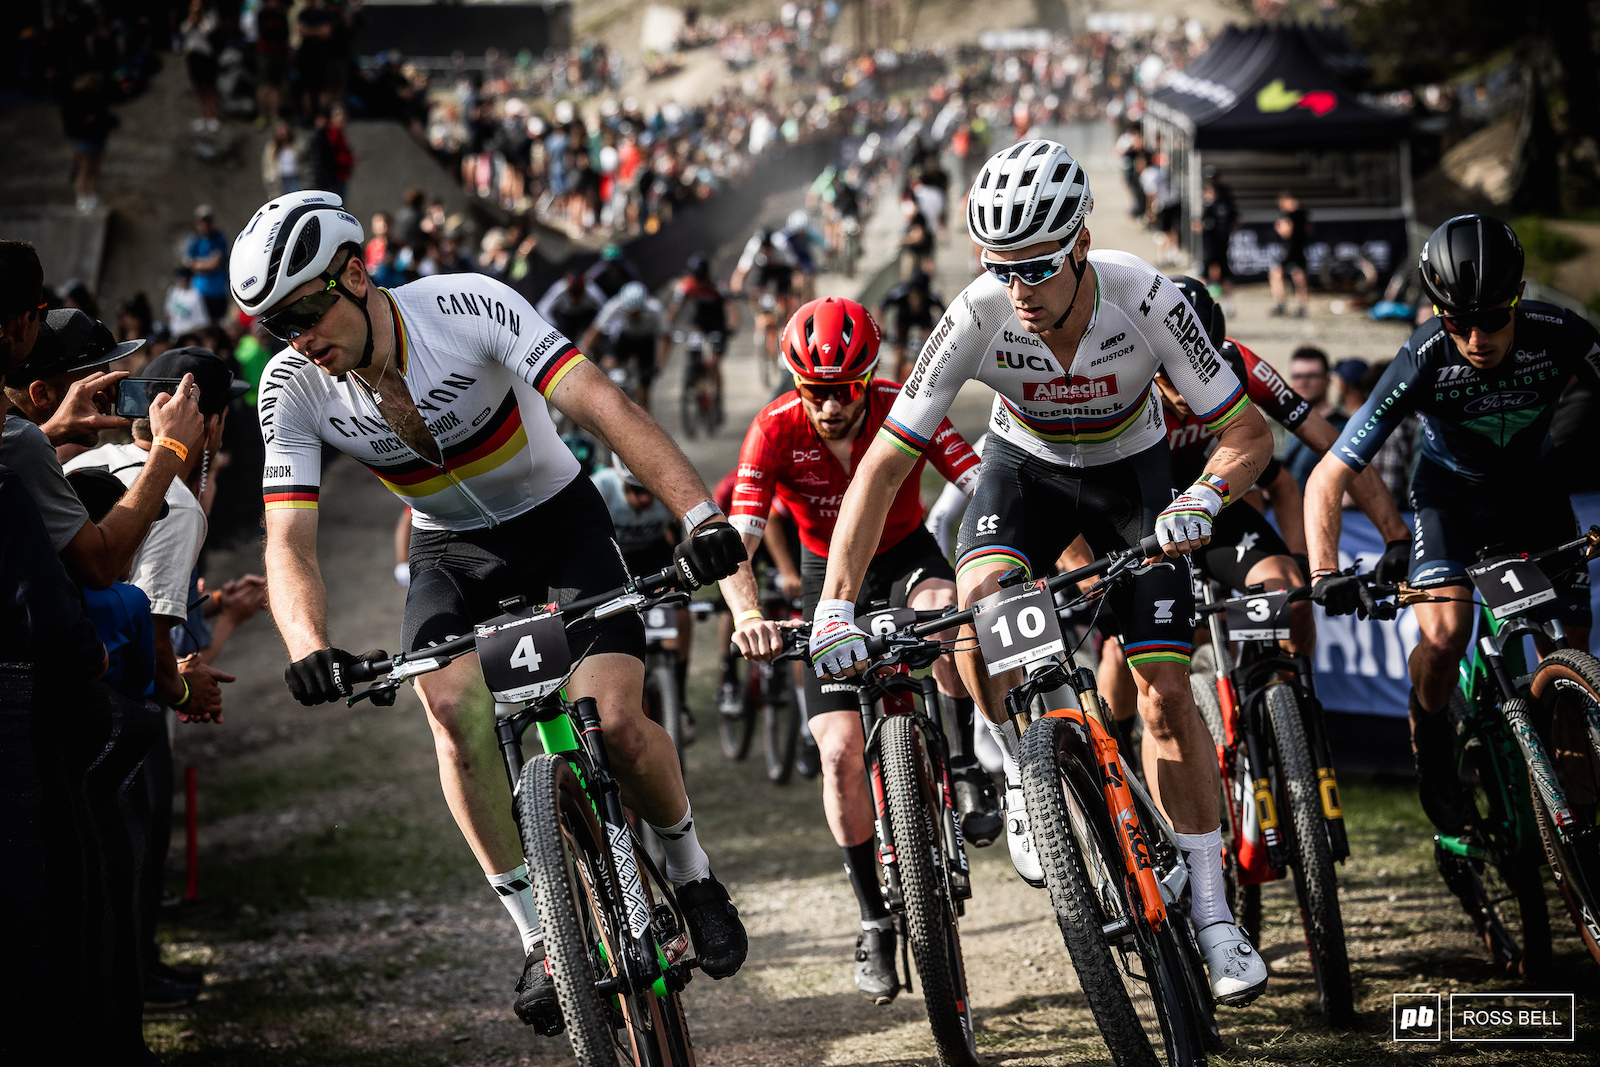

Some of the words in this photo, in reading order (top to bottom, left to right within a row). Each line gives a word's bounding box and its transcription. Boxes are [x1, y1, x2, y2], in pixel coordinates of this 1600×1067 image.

[1066, 195, 1089, 230] CANYON
[264, 220, 281, 254] CANYON
[1147, 274, 1164, 301] ZWIFT
[436, 292, 520, 337] CANYON
[904, 314, 956, 400] deceuninck
[1163, 317, 1182, 344] HAIR
[1183, 340, 1210, 386] BOOSTER
[1168, 301, 1221, 379] Alpecin
[928, 350, 951, 388] WINDOWS
[1006, 351, 1055, 372] UCI
[1514, 360, 1552, 376] SRAM
[1034, 380, 1108, 398] Alpecin
[1252, 360, 1293, 405] BMC
[260, 356, 308, 444] CANYON
[1350, 382, 1408, 446] ROCKRIDER
[1478, 394, 1525, 412] Ford
[451, 427, 469, 440] SWISS
[678, 556, 700, 588] ERGON
[1500, 569, 1524, 594] 1
[870, 614, 897, 637] 6
[990, 606, 1046, 648] 10
[1246, 598, 1270, 622] 3
[510, 634, 542, 672] 4
[332, 662, 347, 694] ERGON
